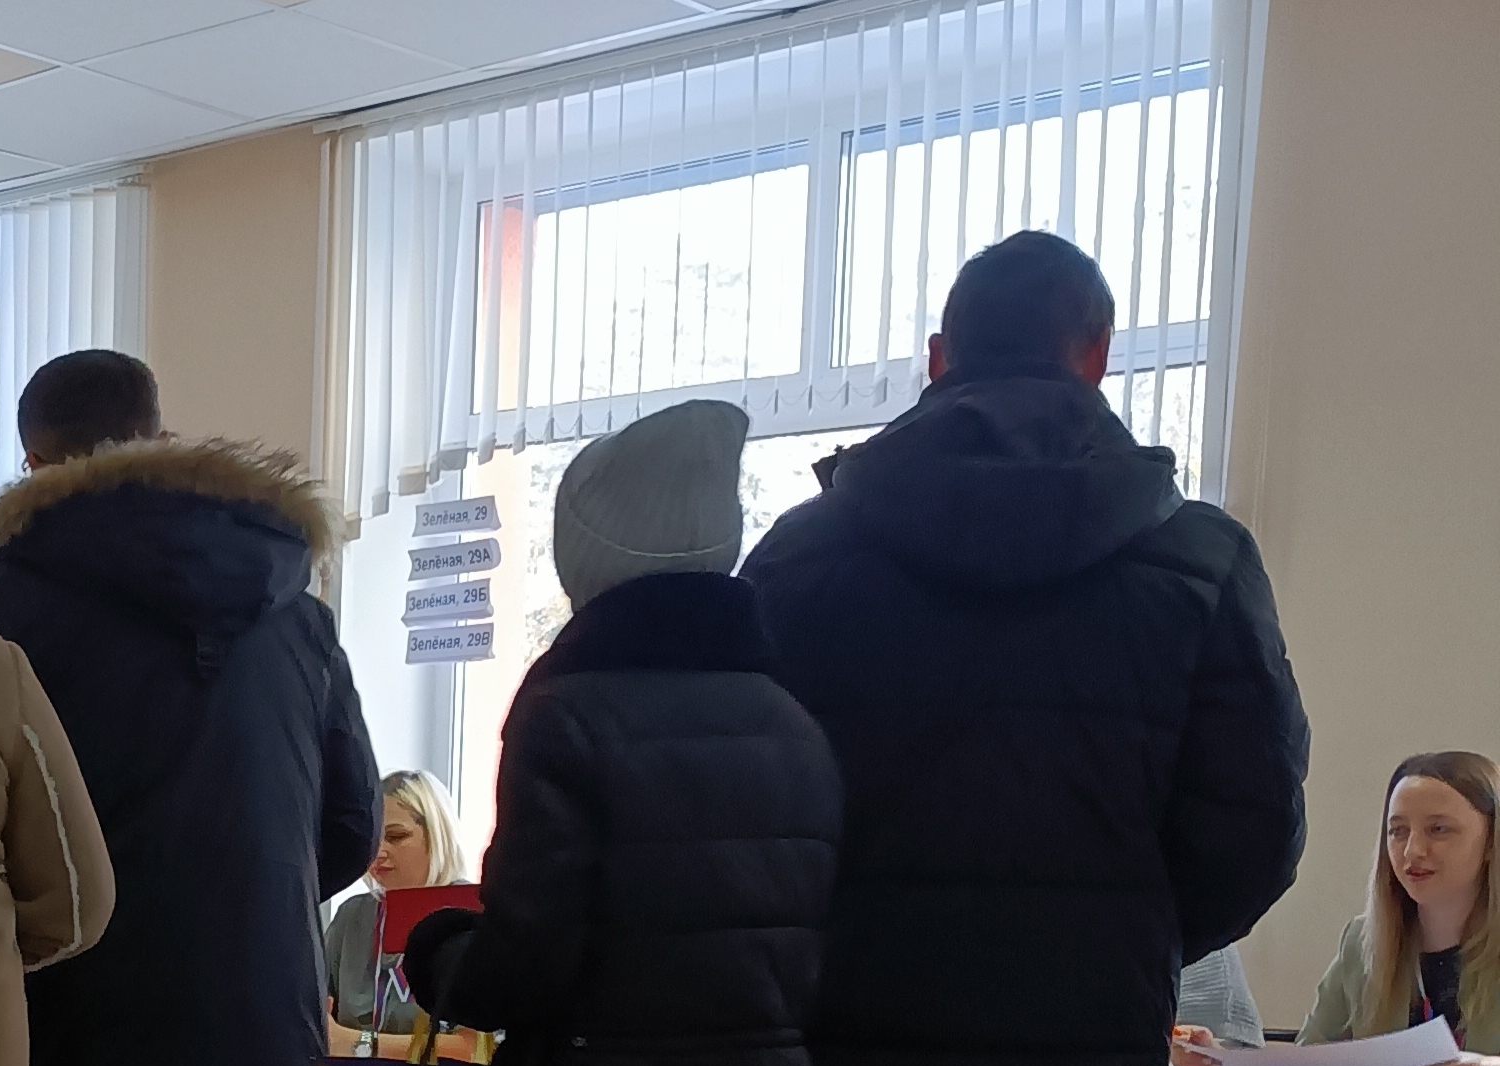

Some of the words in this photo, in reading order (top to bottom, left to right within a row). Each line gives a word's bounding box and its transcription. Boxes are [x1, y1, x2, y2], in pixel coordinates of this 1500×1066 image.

[422, 510, 471, 527] Зелёная,
[474, 505, 488, 521] 29
[413, 555, 466, 573] Зелёная,
[467, 548, 492, 565] 29А
[408, 593, 460, 612] Зелёная,
[463, 587, 487, 604] 29Б
[410, 635, 463, 652] Зелёная,
[466, 631, 490, 647] 29В
